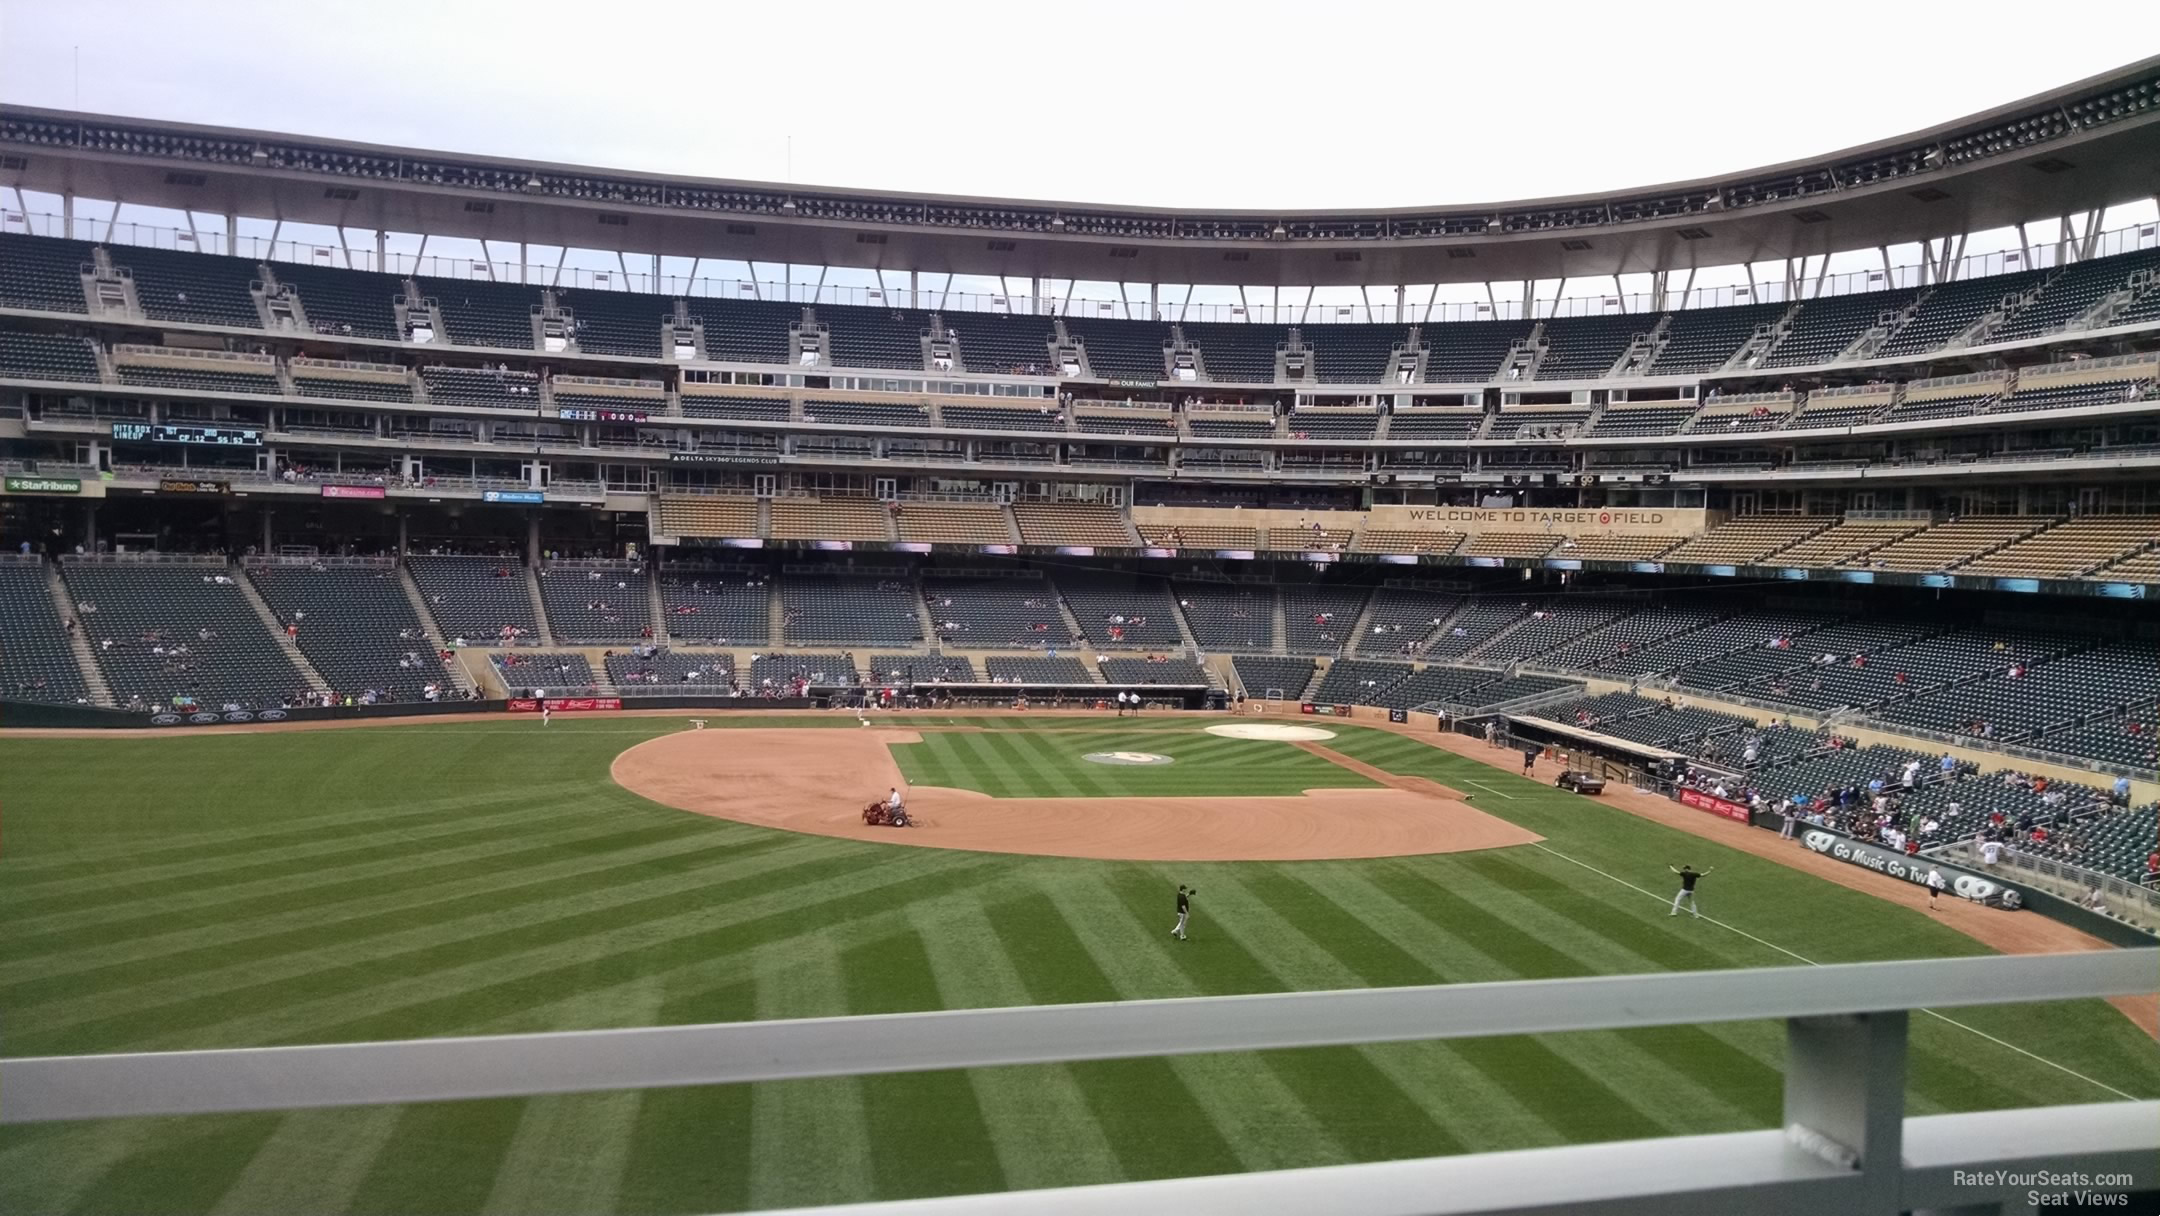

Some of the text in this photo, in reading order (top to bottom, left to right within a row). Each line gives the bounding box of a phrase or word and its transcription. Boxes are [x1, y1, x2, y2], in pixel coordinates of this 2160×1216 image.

[114, 431, 144, 440] LINEUP
[179, 434, 190, 442] CF
[195, 435, 205, 443] 12
[21, 480, 78, 491] StarTribune
[1409, 510, 1663, 524] WELCOME TO TARGET FIELD
[1834, 843, 1850, 858] Go
[1852, 849, 1885, 870] Music
[1888, 860, 1906, 877] Go
